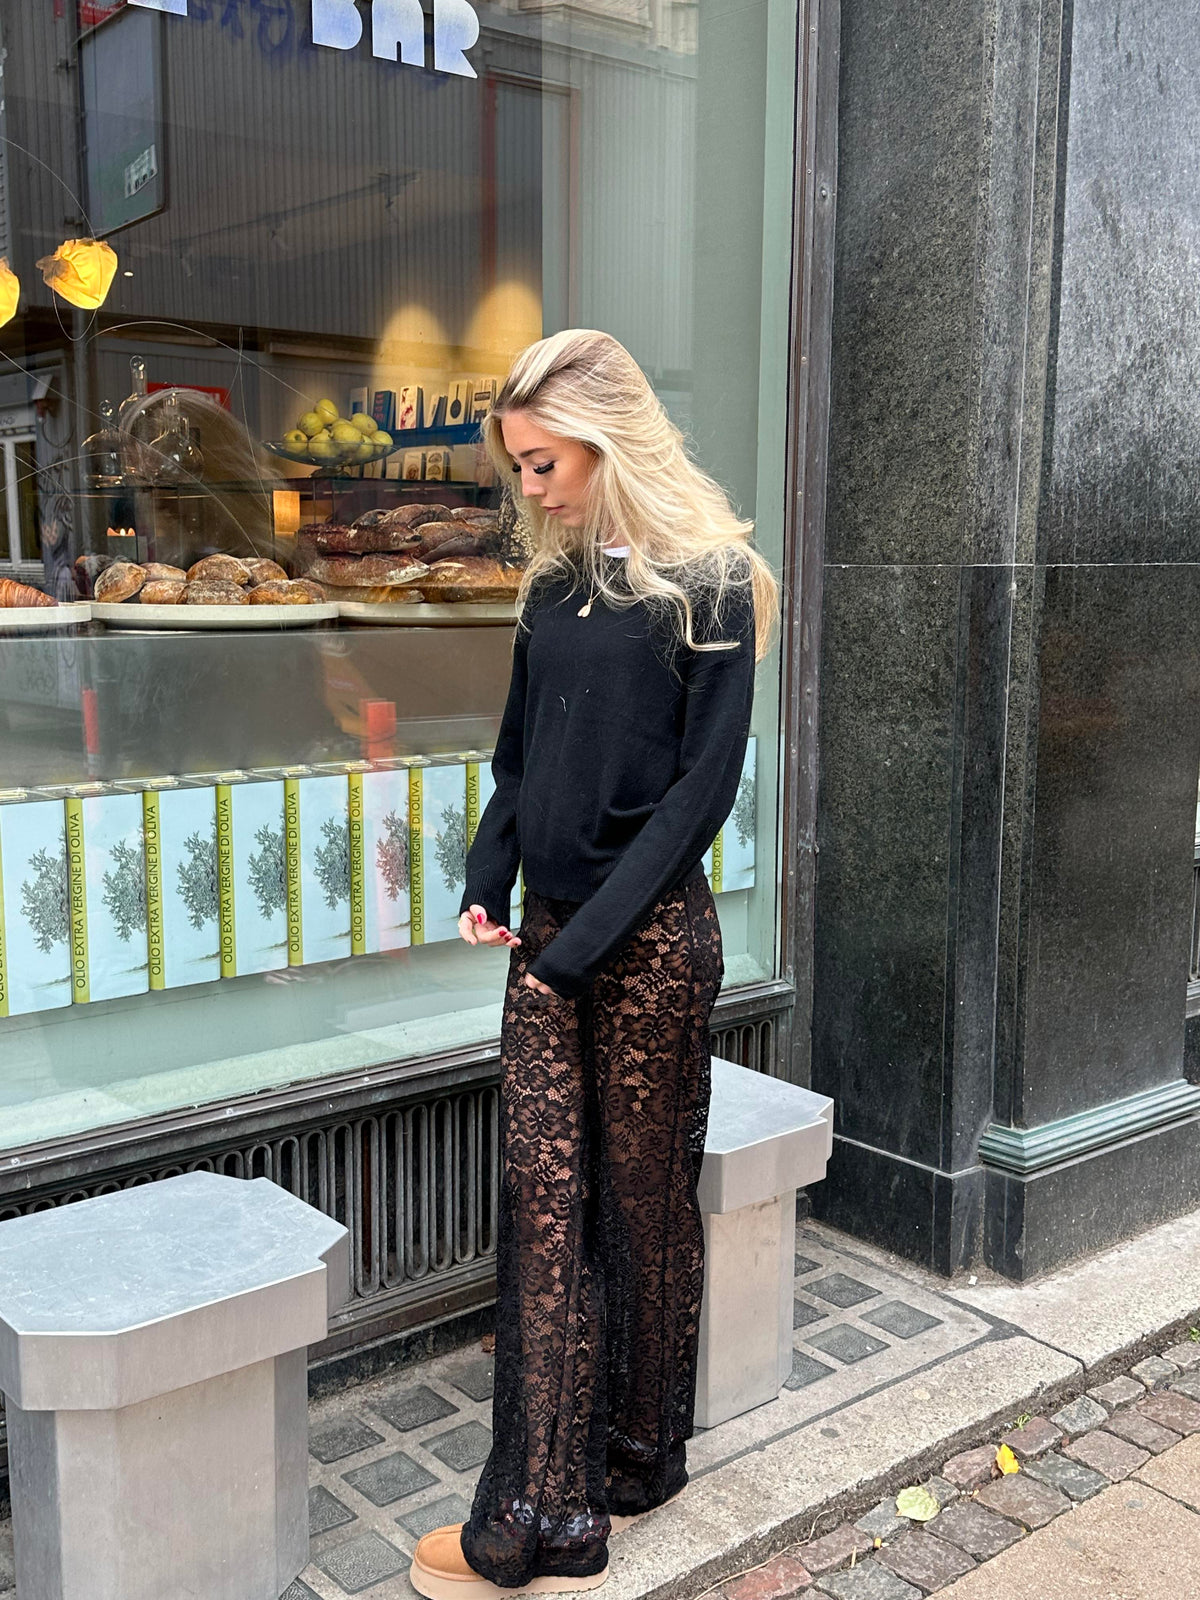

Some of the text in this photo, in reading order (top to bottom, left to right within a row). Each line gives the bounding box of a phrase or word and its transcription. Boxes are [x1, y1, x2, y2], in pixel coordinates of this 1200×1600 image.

[311, 0, 480, 79] BAR
[351, 786, 363, 941] OLIO EXTRA VERGINE DI OLIVA
[411, 780, 422, 932] OLIO EXTRA VERGINE DI OLIVA
[468, 774, 477, 804] OLIVA
[468, 807, 478, 818] DI
[713, 833, 721, 882] OLIO EXTR
[70, 812, 86, 989] OLIO EXTRA VERGINE DI OLIVA
[146, 805, 161, 975] OLIO EXTRA VERGINE DI OLIVA
[219, 798, 233, 963] OLIO EXTRA VERGINE DI OLIVA
[287, 792, 300, 953] OLIO EXTRA VERGINE DI OLIVA
